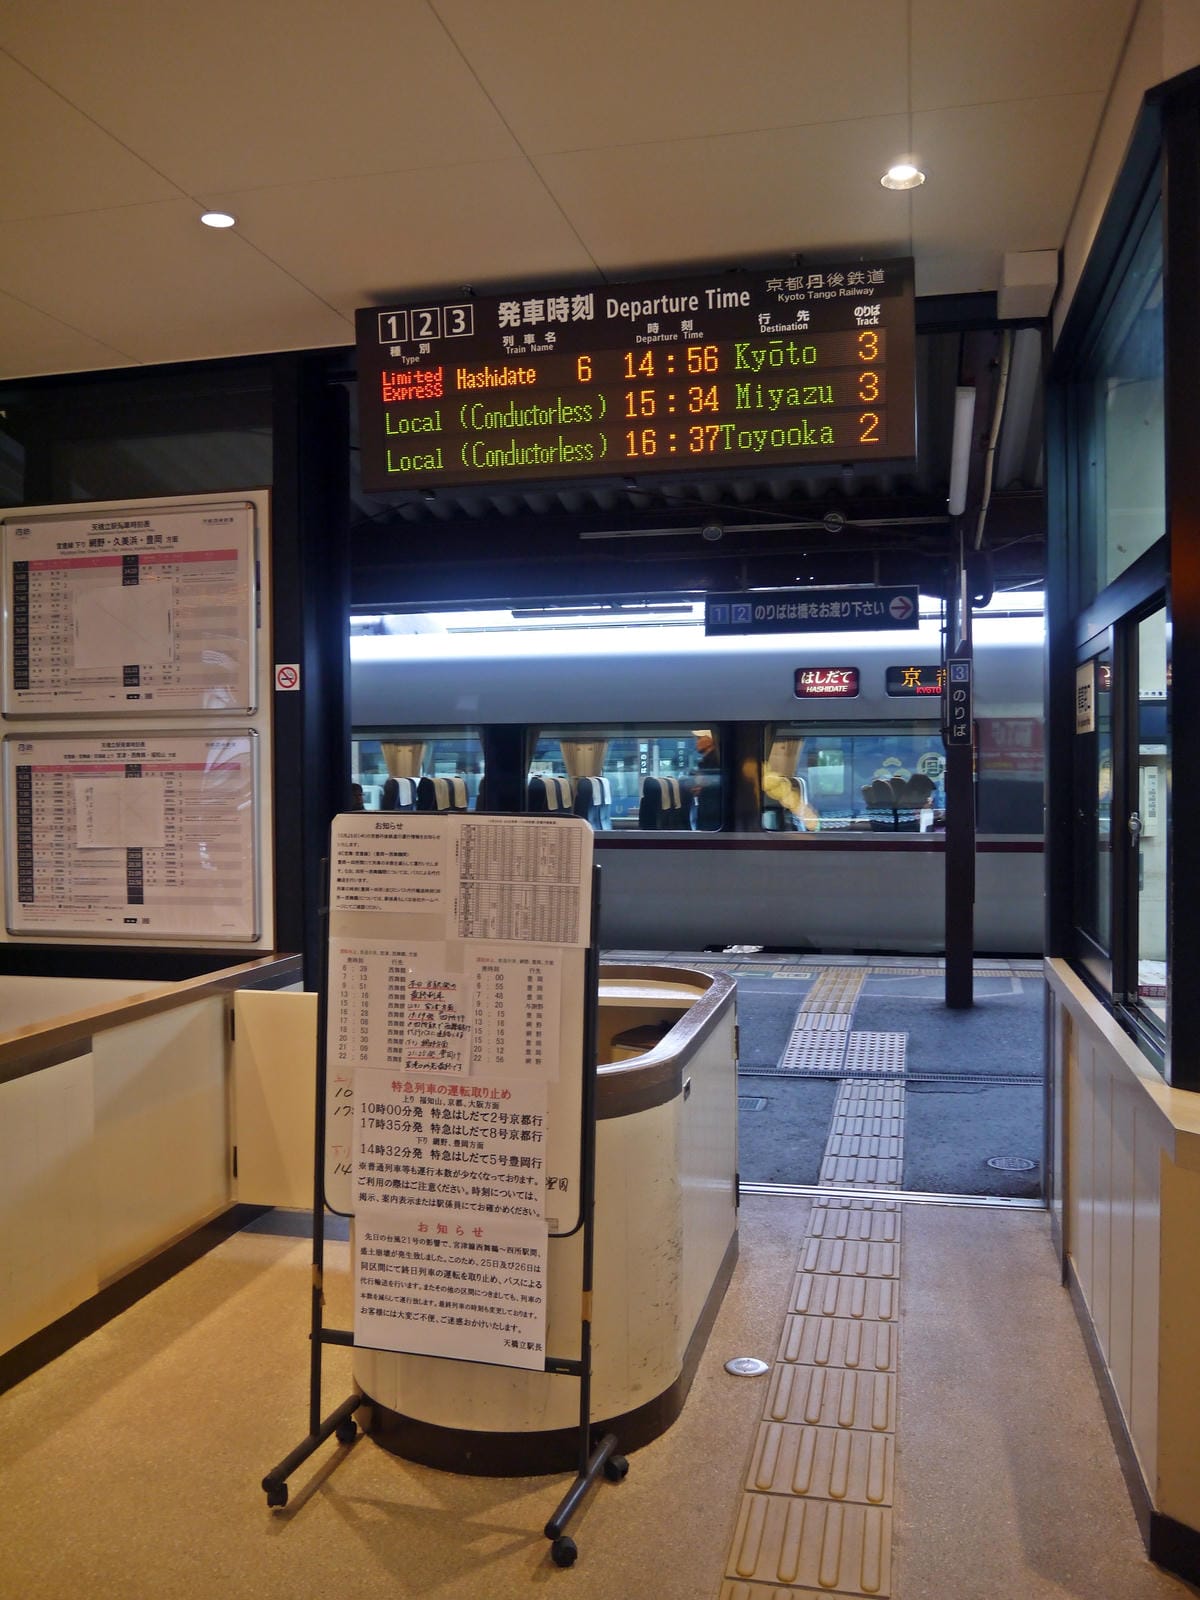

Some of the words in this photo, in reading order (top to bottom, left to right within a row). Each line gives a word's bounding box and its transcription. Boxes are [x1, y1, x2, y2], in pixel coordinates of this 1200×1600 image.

[766, 269, 885, 292] 京都丹後鉄道
[778, 292, 805, 303] Kyoto
[807, 290, 837, 300] Tango
[839, 287, 875, 297] Railway
[498, 293, 595, 328] 発車時刻
[606, 294, 699, 322] Departure
[705, 288, 751, 310] Time
[854, 304, 881, 317] のりば
[387, 316, 398, 339] 1
[419, 312, 433, 336] 2
[452, 309, 466, 334] 3
[758, 309, 810, 325] 行先
[856, 316, 879, 326] Track
[647, 319, 693, 335] 時刻
[760, 322, 809, 334] Destination
[502, 332, 556, 347] 列車名
[636, 333, 678, 344] Departure
[684, 330, 704, 340] Time
[506, 345, 526, 355] Train
[530, 343, 554, 352] Name
[401, 355, 420, 365] Type
[456, 366, 537, 390] Hashidate
[577, 355, 592, 383] 6
[624, 345, 718, 378] 14:56
[734, 340, 817, 372] Kyōto
[858, 331, 879, 360] 3
[382, 366, 443, 386] Limited
[385, 410, 443, 435] Local
[460, 393, 607, 430] (Conductorless)
[624, 384, 719, 417] 15:34
[735, 383, 835, 411] Miyazu
[859, 372, 879, 401] 3
[387, 448, 444, 472] Local
[461, 432, 608, 468] (Conductorless)
[626, 424, 720, 457] 16:37
[720, 420, 835, 452] Toyooka
[859, 413, 879, 442] 2
[755, 601, 885, 621] のりばは橋をお渡り下さい
[801, 670, 852, 685] はしだて
[955, 666, 964, 680] 3
[806, 685, 849, 693] HASHIDATE
[953, 689, 966, 737] のりば
[375, 822, 403, 830] お知らせ
[391, 1080, 512, 1100] 特急列車の運転取り止め
[420, 1096, 500, 1110] 福知山、京都、大阪方面
[361, 1102, 423, 1118] 10時00分発
[431, 1107, 543, 1127] 特急はしだて2号京都行
[361, 1117, 423, 1133] 17時35分発
[430, 1123, 543, 1142] 特急はしだて8号京都行
[416, 1137, 428, 1145] 下り
[432, 1138, 484, 1149] 網野、豊岡方面
[361, 1143, 423, 1159] 14時32分発
[430, 1149, 543, 1169] 特急はしだて5号豊岡行
[418, 1222, 484, 1238] お知らせ
[504, 1338, 543, 1352] 天橋立駅長
